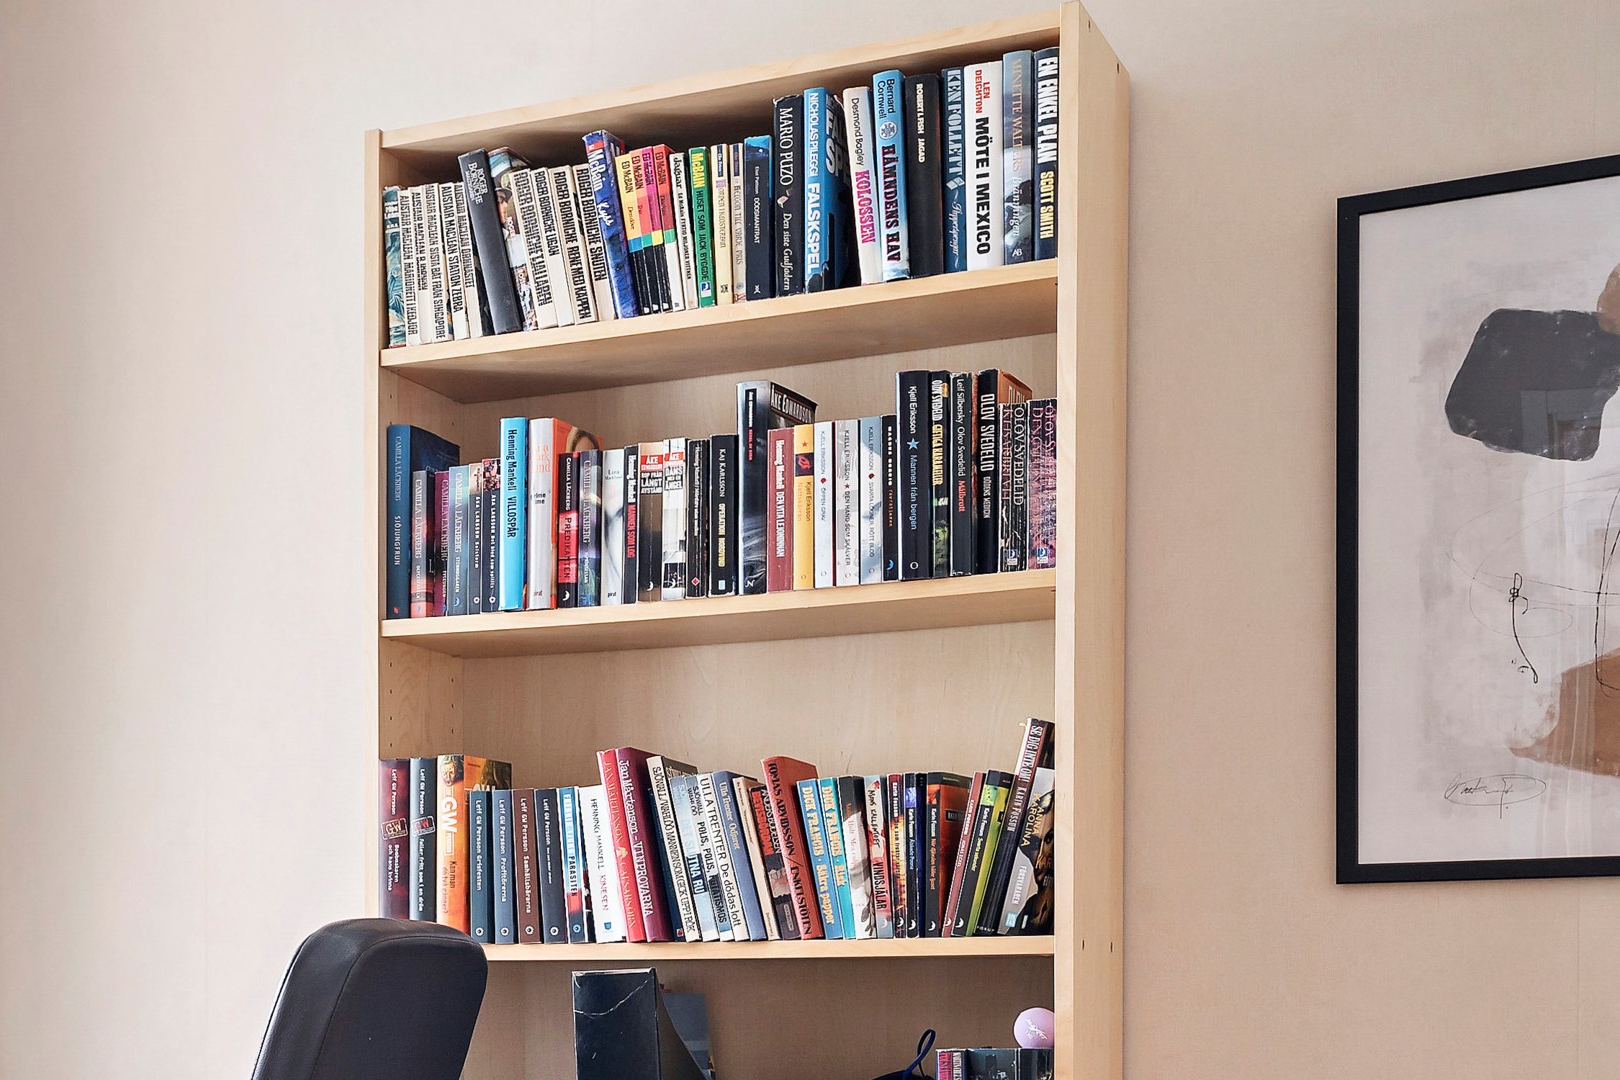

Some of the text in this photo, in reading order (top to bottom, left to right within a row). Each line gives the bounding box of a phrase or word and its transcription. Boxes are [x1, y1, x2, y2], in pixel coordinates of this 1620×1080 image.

[877, 80, 886, 119] Cornwell
[886, 78, 895, 114] Bernard
[947, 70, 961, 102] KEN
[975, 70, 983, 113] DEIGHTON
[947, 105, 962, 176] FOLLETT
[975, 117, 992, 168] MÖTE
[1036, 57, 1057, 239] EN ENKEL PLAN SCOTT SMITH
[587, 150, 612, 227] McBain Kyss
[673, 157, 682, 189] Jaguar
[692, 153, 705, 188] McBAIN
[807, 93, 819, 274] NICHOLAS PILEGGI FALSKSPEL
[851, 98, 875, 244] Desmond Bagley KOLOSSEN
[697, 190, 705, 212] HUSET
[779, 108, 792, 290] MARIO PUZO Den siste Gudfadern
[882, 144, 900, 262] HÄMNDENS HAV
[976, 184, 990, 254] MEXICO
[576, 169, 607, 281] ROGER BORNICHE SNUTEN
[697, 215, 705, 231] SOM
[441, 186, 463, 313] ALISTAIR MACLEAN STATION ZEBRA
[700, 253, 708, 280] BYGGDE
[908, 386, 917, 401] Kjell
[980, 394, 994, 420] OLOV
[909, 403, 917, 434] Eriksson
[955, 379, 966, 512] Leif Silbersky Olov Svedelid Målbrott
[980, 425, 994, 471] SVEDELID
[506, 429, 518, 538] Henning Mankell VILLOSPÅR
[910, 487, 918, 502] från
[983, 476, 991, 496] DÖDENS
[909, 503, 917, 529] bergen
[394, 516, 402, 565] SJÖJUNGFRUN
[1007, 726, 1043, 832] SE DIG INTE OM! KARIN FOSSUM
[441, 797, 457, 833] GW
[476, 816, 482, 824] GW
[521, 814, 527, 823] GW
[1021, 793, 1041, 847] KAROLINA
[1033, 806, 1044, 834] ANNA
[619, 760, 654, 917] Jan Mårtenson VINPROVARNA
[699, 778, 742, 927] ULLA TRENTER De dödas lott
[802, 787, 834, 924] DICK FRANCIS Säkra papper
[523, 855, 531, 913] Samhällsbärarna
[1012, 866, 1027, 905] FÖRSVARAREN
